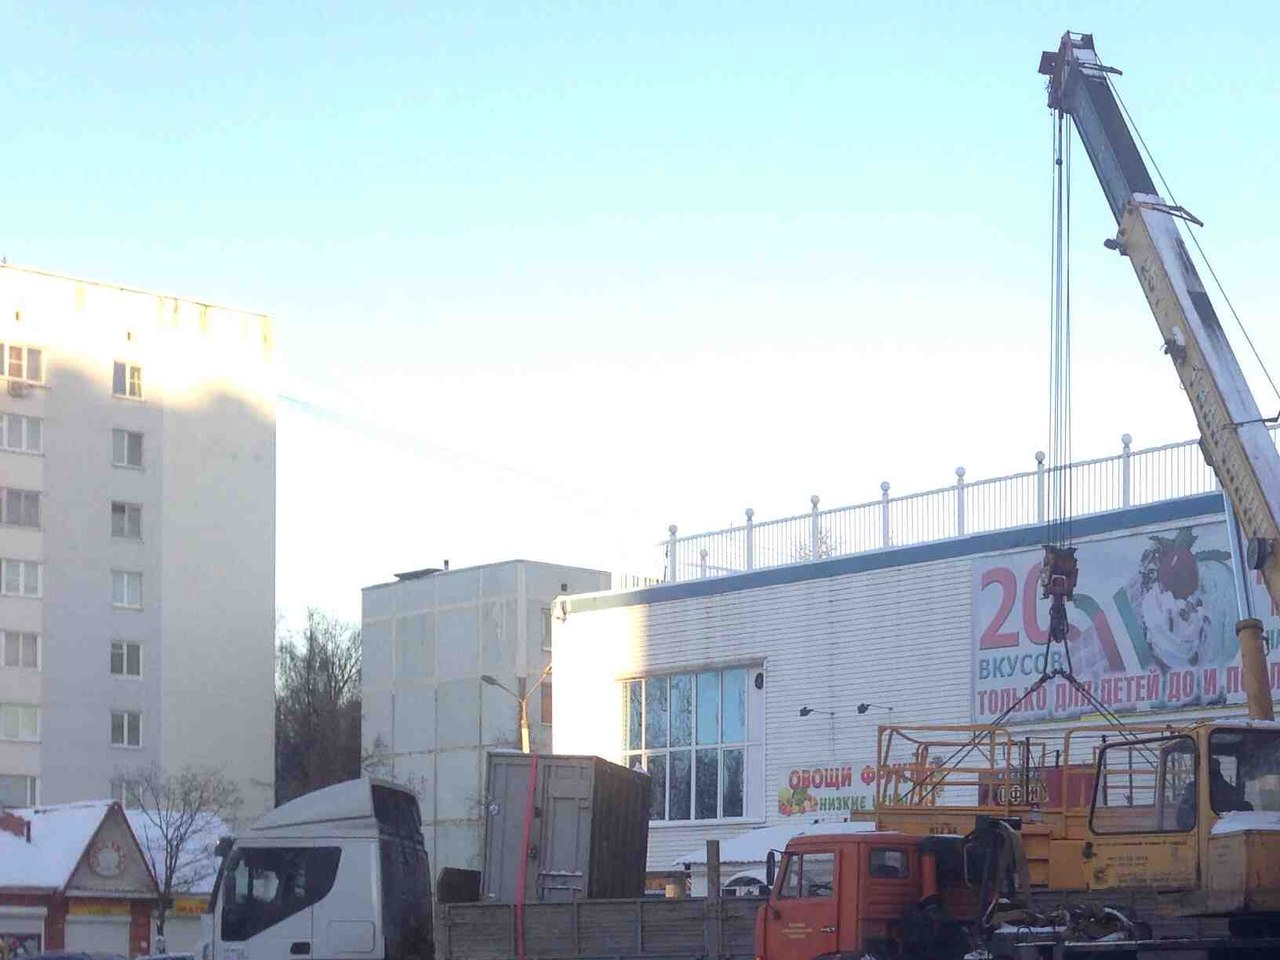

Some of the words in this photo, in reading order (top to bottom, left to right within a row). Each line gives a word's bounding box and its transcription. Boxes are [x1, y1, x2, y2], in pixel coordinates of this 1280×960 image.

[978, 651, 1063, 680] ВКУСОВ
[978, 686, 1047, 715] ТОЛЬКО
[1055, 680, 1092, 712] ДЛЯ
[1100, 669, 1160, 705] ДЕТЕЙ
[1167, 670, 1195, 702] ДО
[1203, 668, 1217, 695] И
[789, 767, 852, 790] ОВОЩИ
[819, 796, 866, 811] НИЗКИЕ
